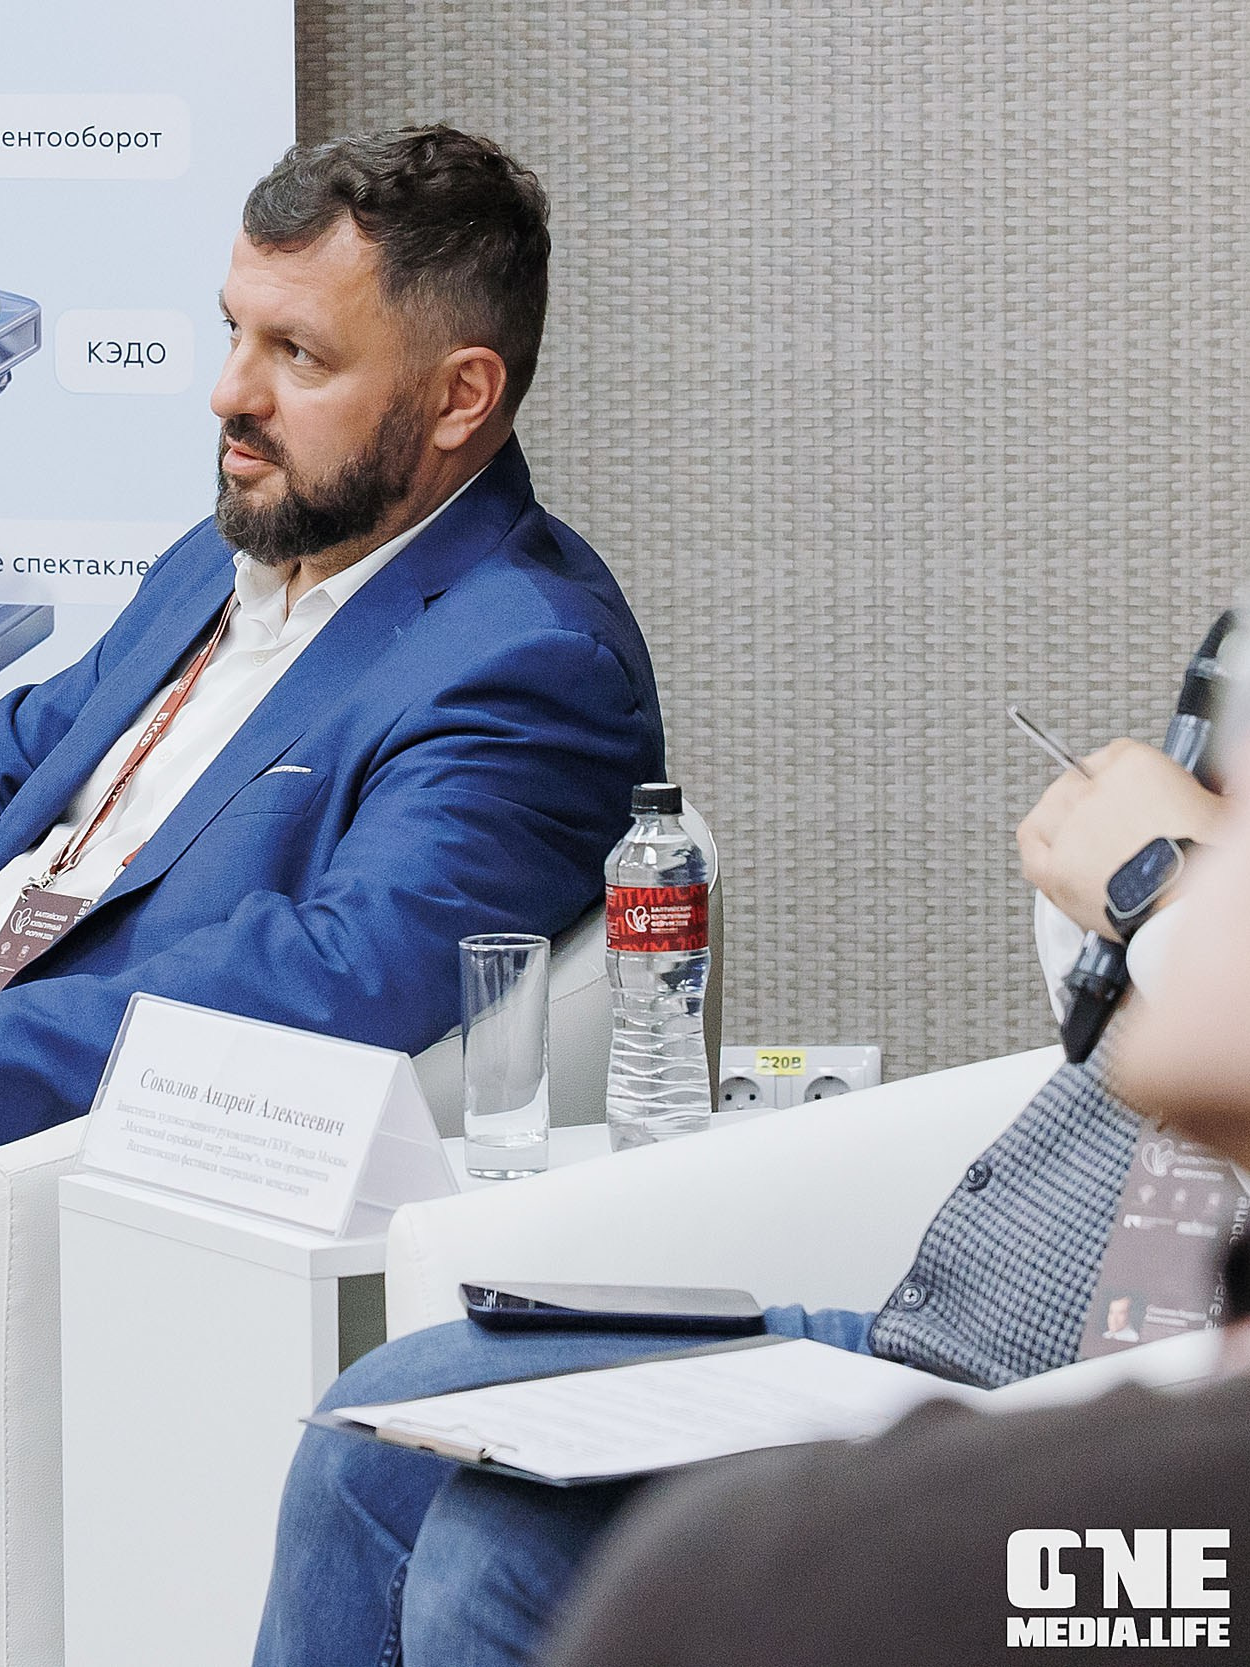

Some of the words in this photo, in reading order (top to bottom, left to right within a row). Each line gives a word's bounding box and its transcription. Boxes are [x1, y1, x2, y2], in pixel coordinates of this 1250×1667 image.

[88, 340, 167, 369] КЭДО
[13, 554, 159, 577] спектакле
[140, 1067, 199, 1100] Соколов
[199, 1084, 255, 1116] Андрей
[257, 1098, 345, 1137] Алексеевич
